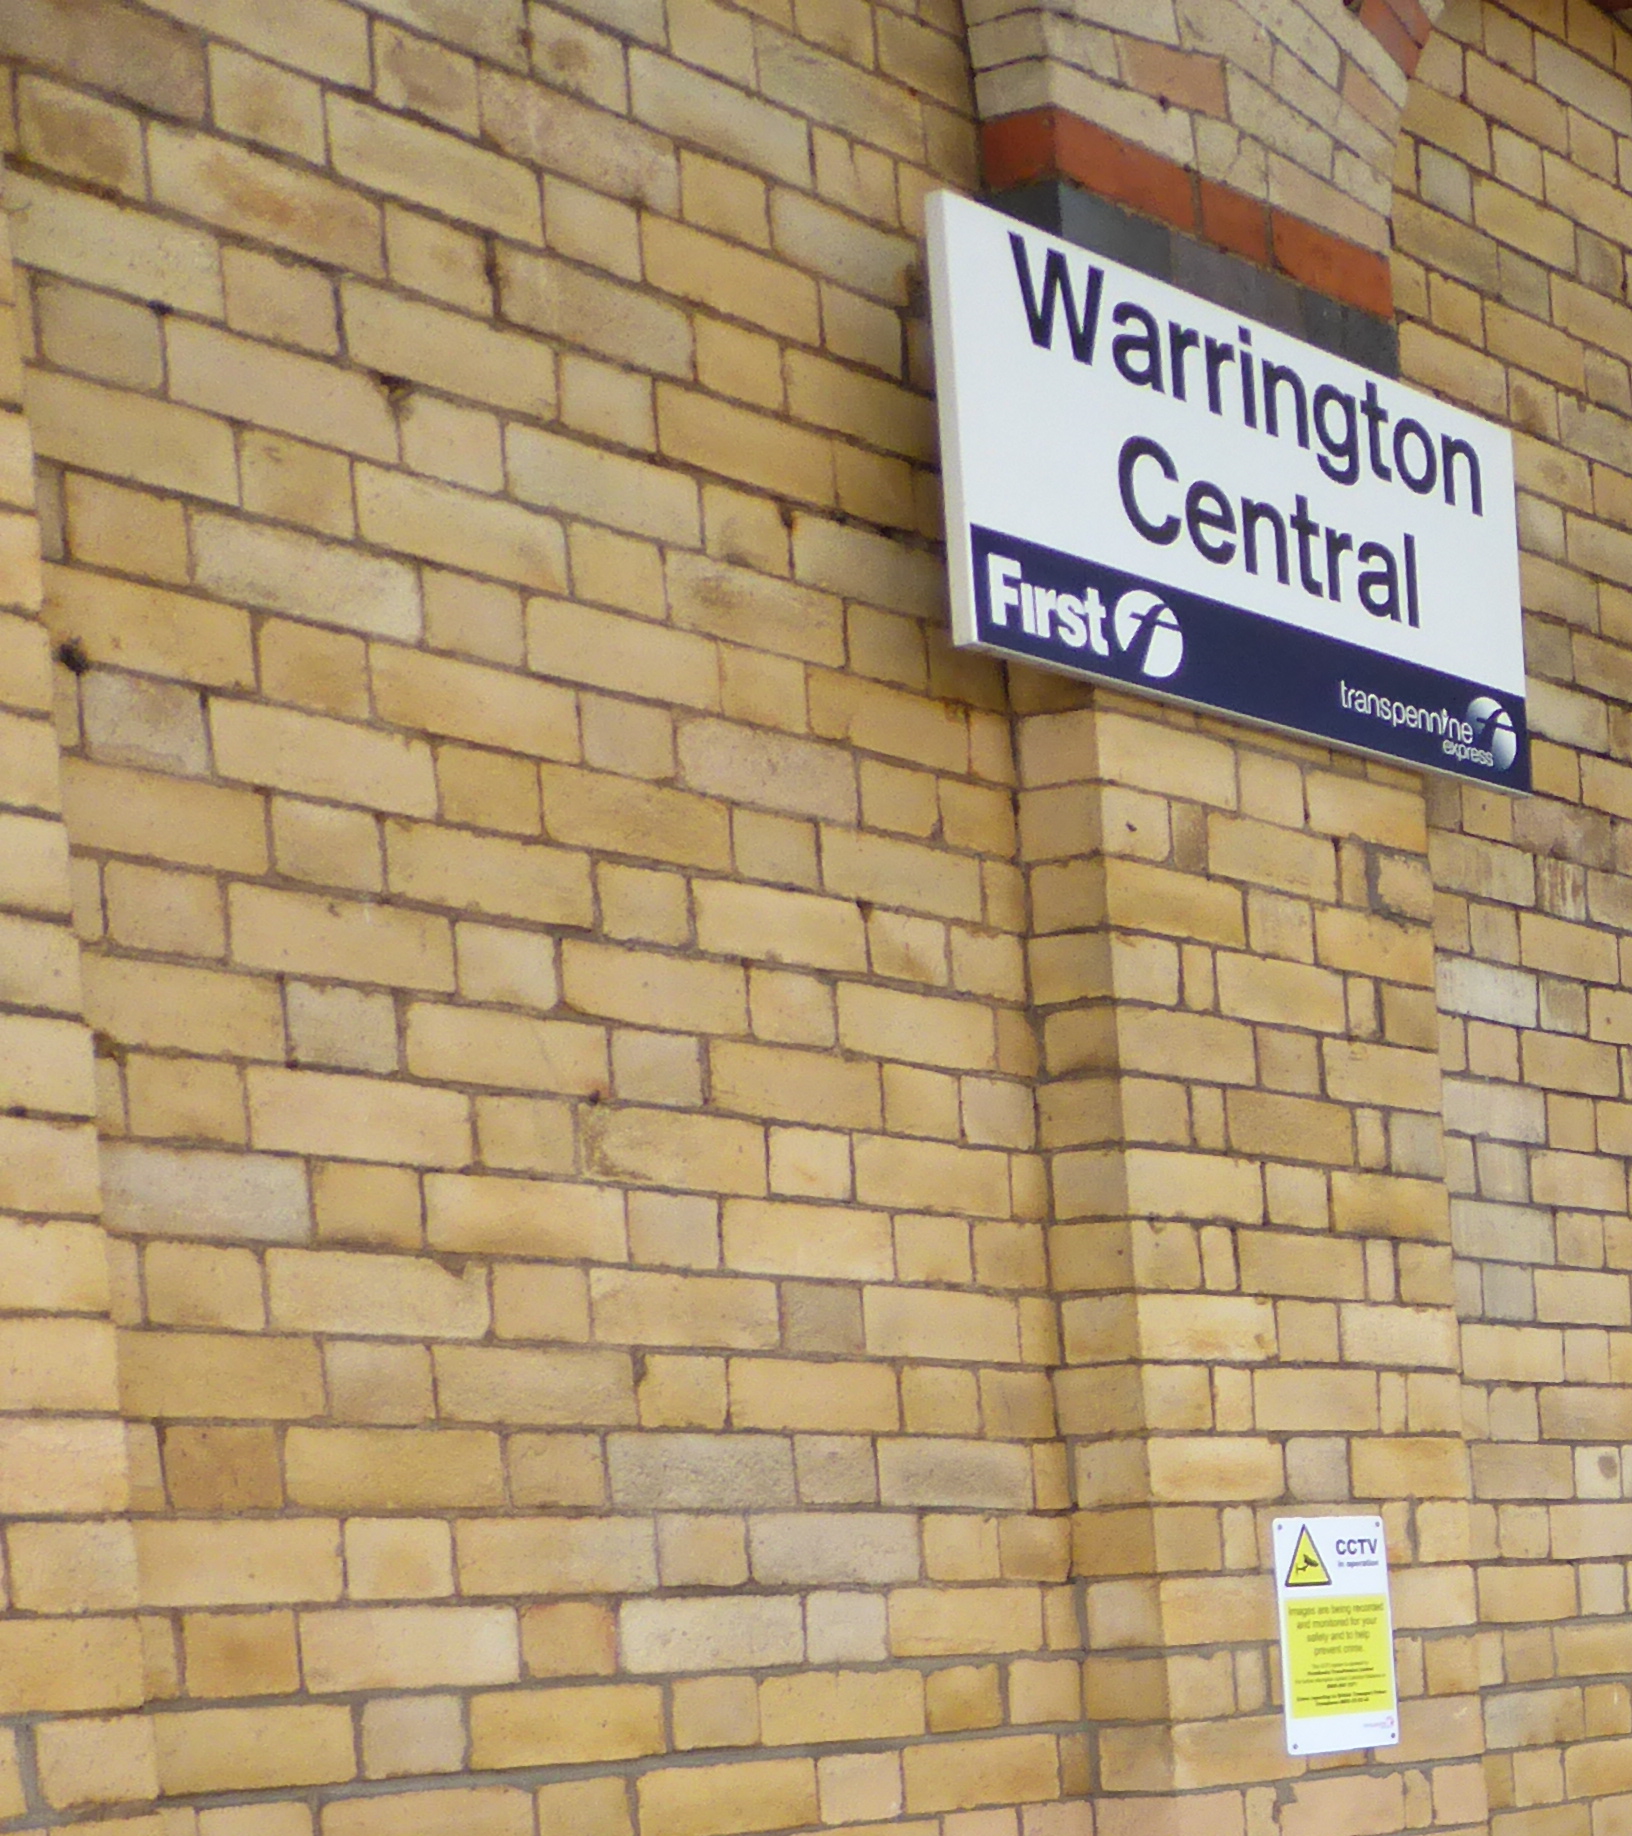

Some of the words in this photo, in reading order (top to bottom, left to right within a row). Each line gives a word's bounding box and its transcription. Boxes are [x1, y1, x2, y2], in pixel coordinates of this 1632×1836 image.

[1007, 229, 1484, 517] Warrington
[1118, 434, 1420, 629] Central
[986, 552, 1110, 657] First
[1340, 678, 1474, 745] transpennine
[1441, 734, 1494, 768] express
[1335, 1538, 1378, 1556] CCTV
[1346, 1560, 1379, 1569] operation
